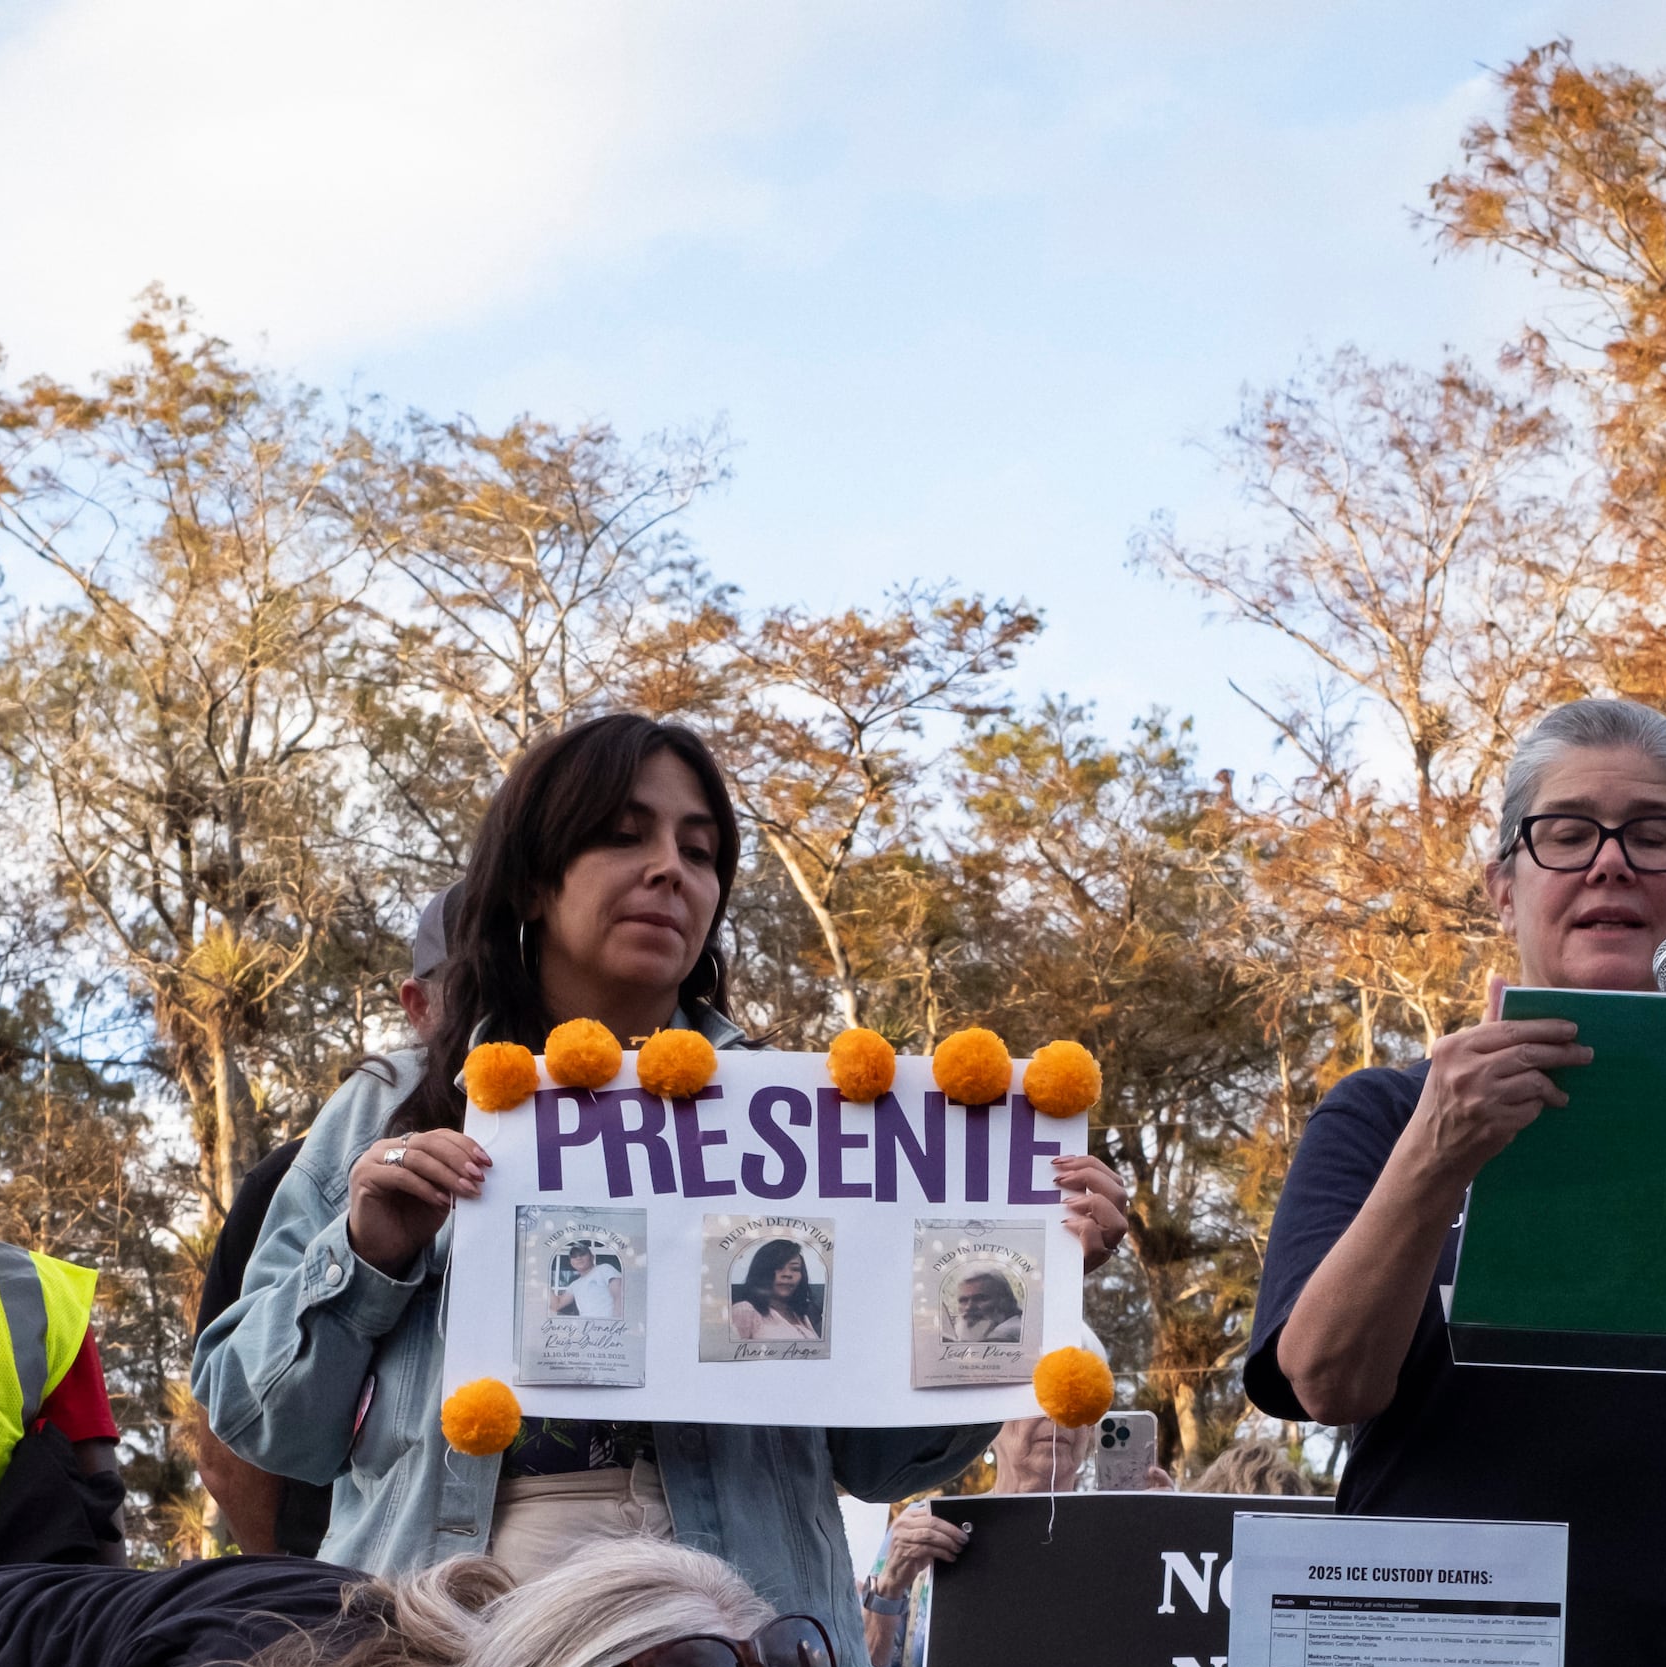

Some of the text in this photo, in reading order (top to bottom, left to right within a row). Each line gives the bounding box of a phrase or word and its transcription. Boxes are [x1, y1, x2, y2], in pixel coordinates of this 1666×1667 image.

[534, 1085, 1062, 1205] PRESENTE
[544, 1224, 628, 1249] DIED IN DETENTION
[718, 1217, 834, 1251] DIED IN DETENTION
[933, 1243, 1034, 1273] DIED IN DETENTION
[734, 1342, 821, 1359] Marie Ange
[1308, 1565, 1493, 1585] 2025 ICE CUSTODY DEATHS:
